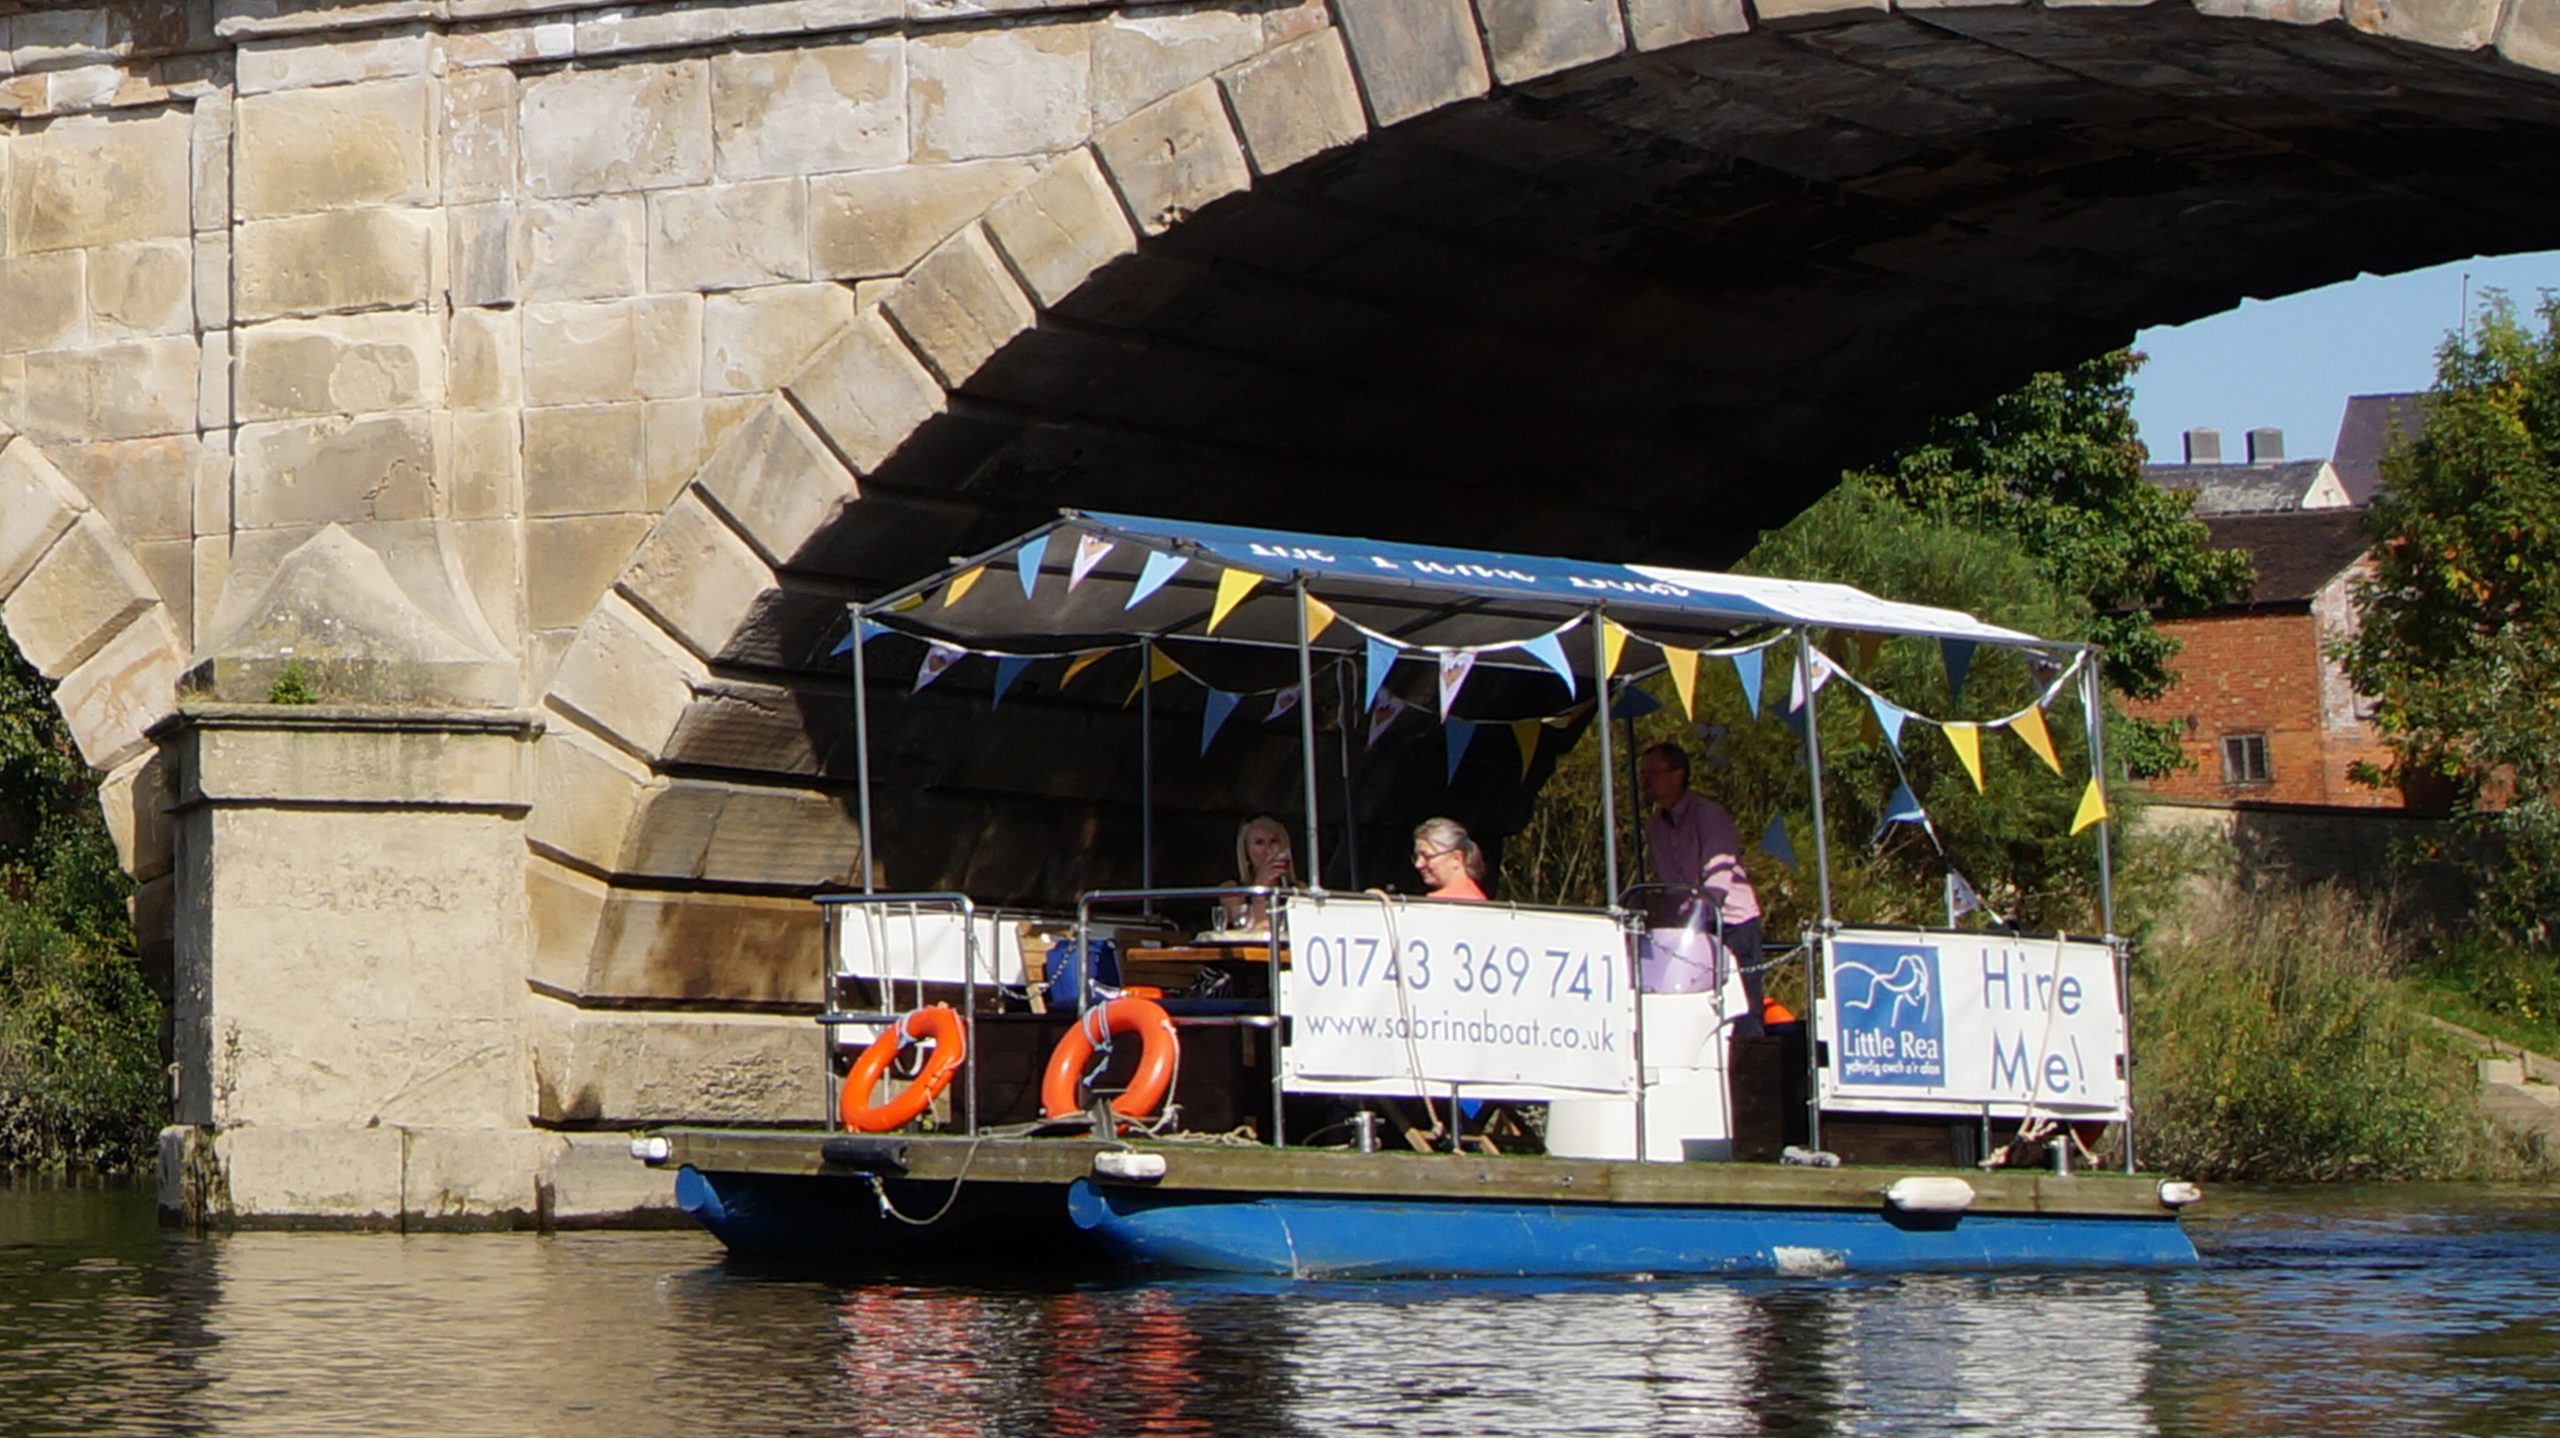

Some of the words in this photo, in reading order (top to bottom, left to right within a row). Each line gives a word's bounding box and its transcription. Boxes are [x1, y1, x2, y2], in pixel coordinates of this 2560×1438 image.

[1305, 936, 1431, 991] 01743
[1453, 942, 1530, 996] 369
[1545, 950, 1614, 1003] 741
[1982, 948, 2082, 1015] Hire
[1306, 1005, 1615, 1053] www.sabrinaboat.co.uk
[1843, 1027, 1895, 1058] Little
[1900, 1030, 1938, 1059] Rea
[1991, 1028, 2087, 1095] Me!
